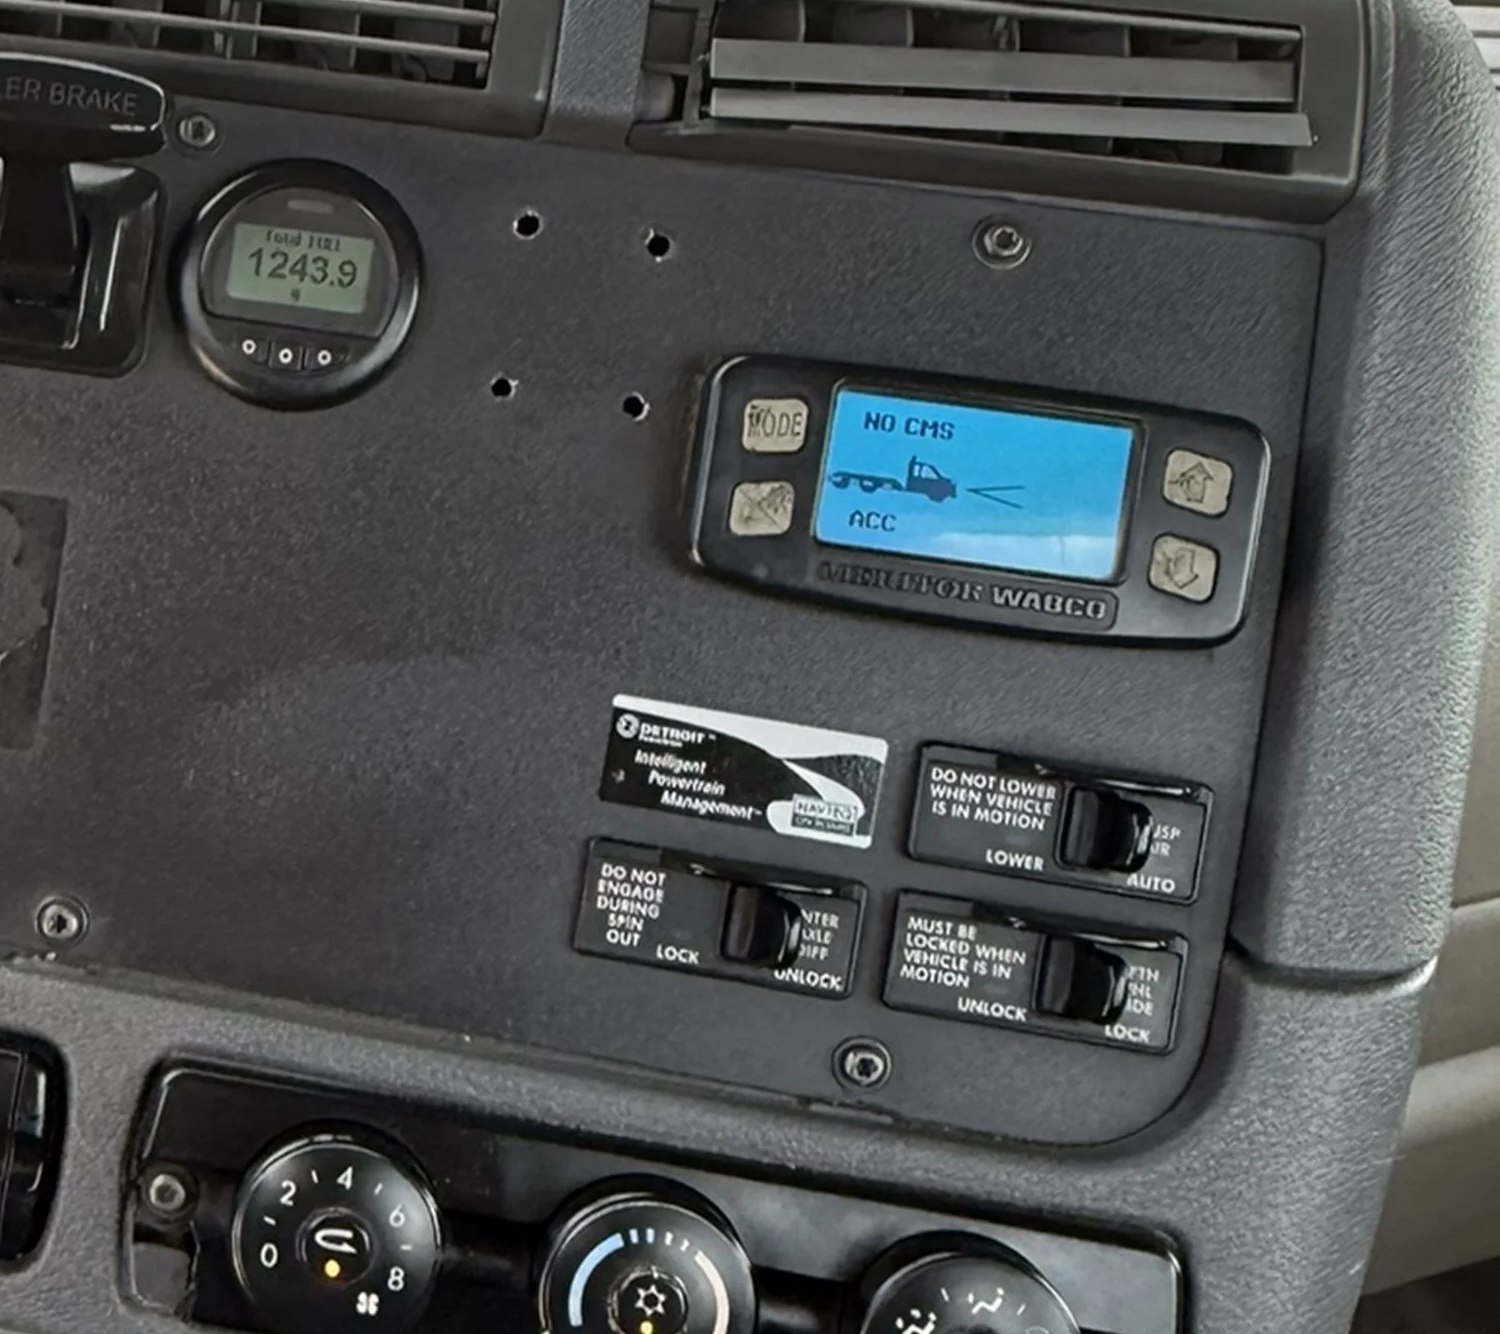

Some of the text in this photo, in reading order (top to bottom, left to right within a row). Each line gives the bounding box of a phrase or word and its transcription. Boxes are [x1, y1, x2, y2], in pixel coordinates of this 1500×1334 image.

[50, 82, 138, 116] BRAKE
[248, 247, 358, 288] 1243.9
[747, 404, 804, 439] MODE
[863, 411, 956, 440] NO CMS
[848, 510, 897, 532] ACC
[991, 584, 1106, 620] WABCO
[634, 749, 707, 775] Intelligent
[648, 770, 726, 796] Powertrain
[931, 766, 1057, 800] DO NOT LOWER
[930, 783, 1053, 816] WHEN VEHICLE
[932, 800, 1046, 832] IS IN MOTION
[986, 849, 1044, 872] LOWER
[601, 863, 667, 887] DO NOT
[1126, 873, 1176, 894] AUTO
[598, 880, 665, 904] ENGAGE
[597, 895, 661, 919] DURING
[608, 913, 644, 932] SPIN
[907, 917, 977, 941] MUST BE
[606, 929, 641, 947] OUT
[906, 933, 1027, 966] LOCKED WHEN
[656, 944, 700, 965] LOCK
[903, 949, 1012, 980] VEHICLE IS IN
[774, 968, 842, 991] UNLOCK
[900, 964, 970, 988] MOTION
[957, 997, 1027, 1022] UNLOCK
[1104, 1025, 1151, 1043] LOCK
[336, 1166, 353, 1190] 4
[280, 1179, 296, 1206] 2
[389, 1203, 405, 1228] 6
[260, 1242, 279, 1268] 0
[387, 1266, 405, 1291] 8
